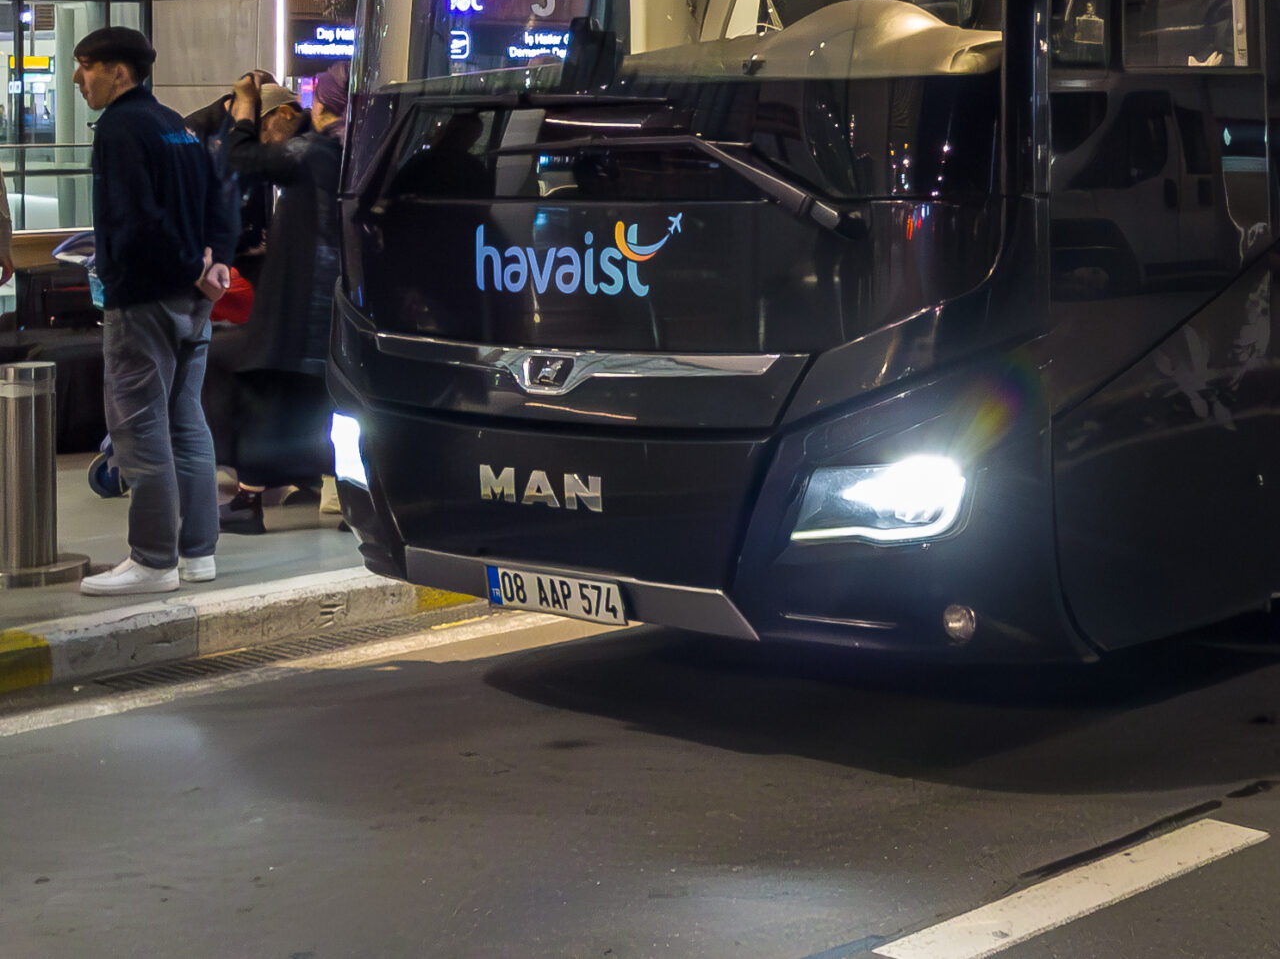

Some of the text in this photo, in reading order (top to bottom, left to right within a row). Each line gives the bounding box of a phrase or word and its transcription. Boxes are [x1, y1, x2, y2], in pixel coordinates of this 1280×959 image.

[476, 221, 652, 297] havaist
[480, 464, 603, 512] MAN
[501, 571, 527, 603] 08
[537, 576, 572, 610] AAP
[578, 582, 618, 619] 574
